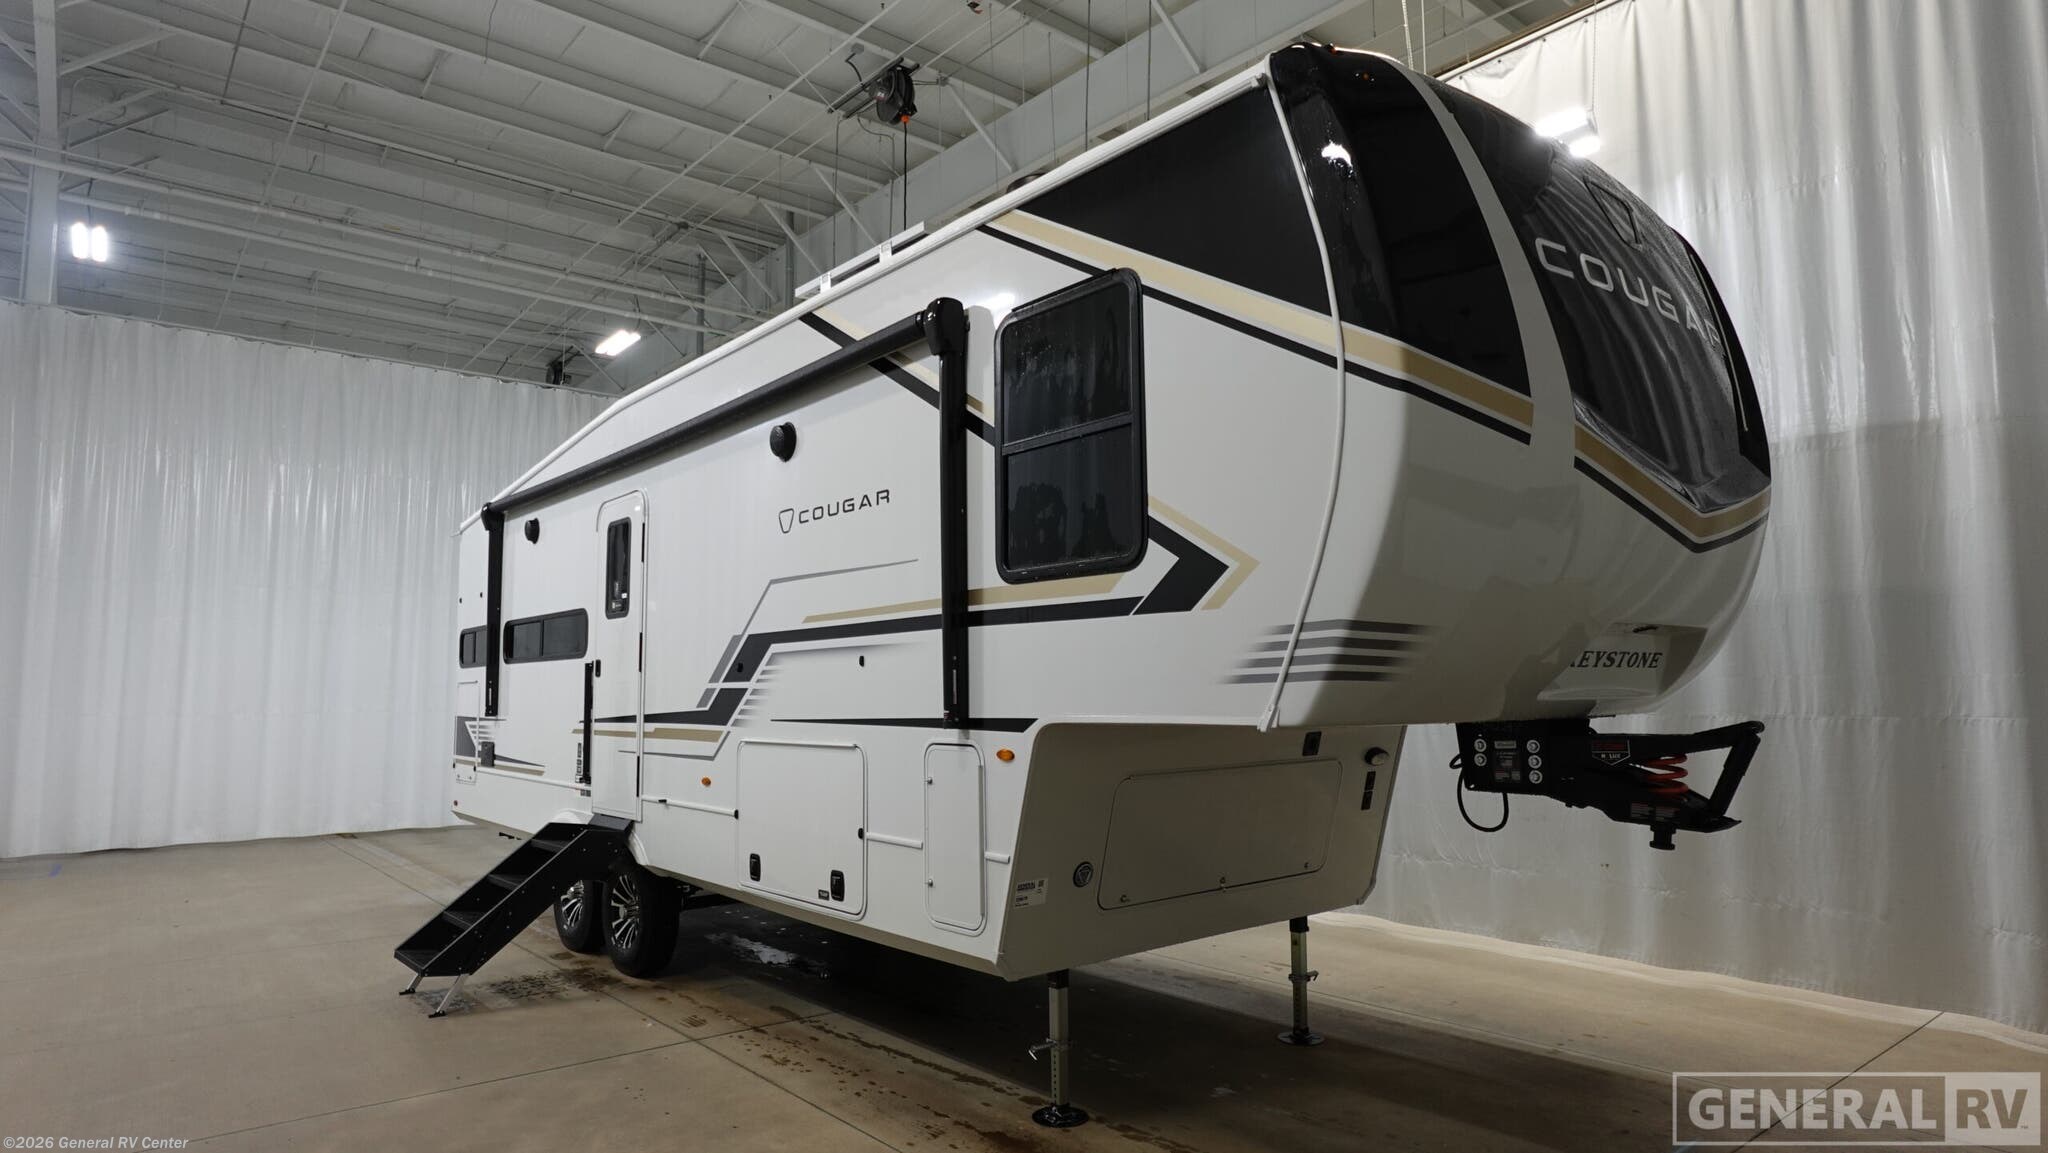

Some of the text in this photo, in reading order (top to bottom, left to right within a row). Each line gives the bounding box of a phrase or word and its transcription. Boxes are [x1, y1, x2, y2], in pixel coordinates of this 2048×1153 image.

[1535, 237, 1721, 348] COUGAR
[798, 489, 890, 524] COUGAR
[1570, 651, 1663, 668] EYSTONE
